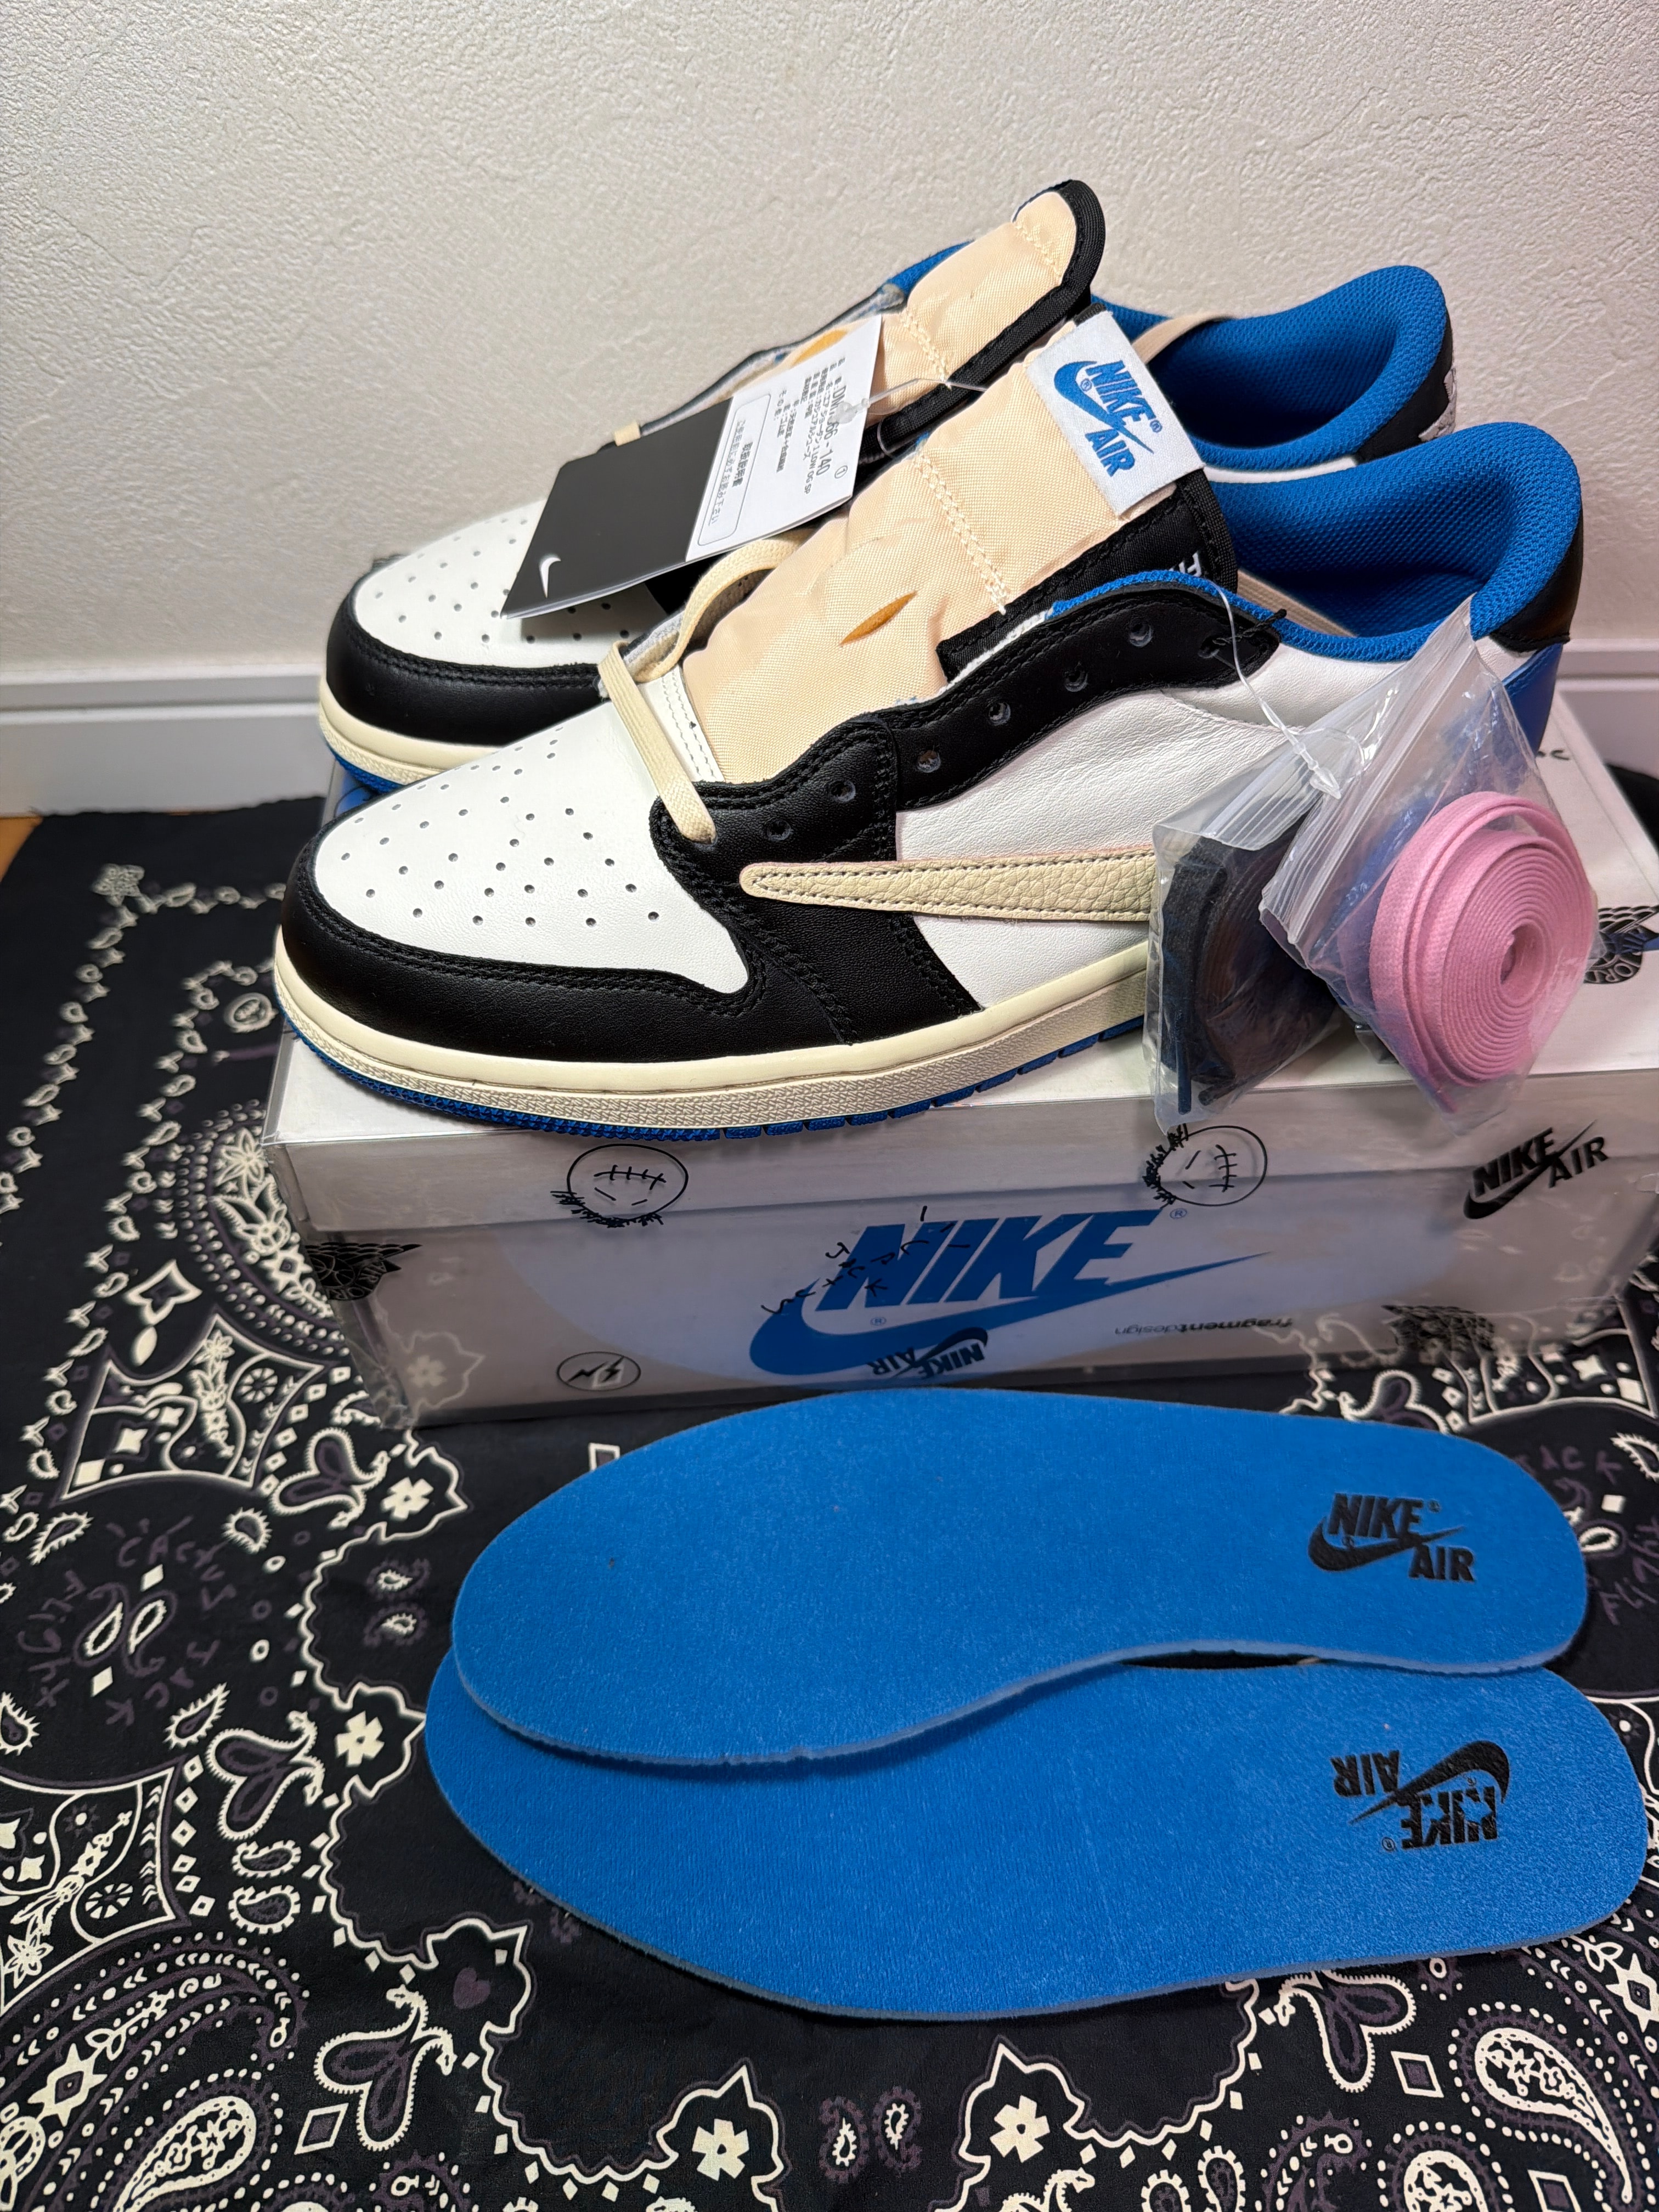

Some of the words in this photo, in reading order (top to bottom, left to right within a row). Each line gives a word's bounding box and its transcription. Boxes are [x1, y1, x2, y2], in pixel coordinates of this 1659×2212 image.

[1085, 359, 1156, 426] NIKE
[816, 385, 847, 476] DM66-140
[1085, 429, 1136, 477] AIR
[1472, 1127, 1554, 1198] NIKE
[1548, 1136, 1608, 1188] AIR
[815, 1209, 1163, 1311] NIKE
[866, 1347, 916, 1376] AIR
[917, 1342, 985, 1380] NIKE
[1327, 1493, 1424, 1539] NIKE
[1408, 1544, 1476, 1583] AIR
[1330, 1750, 1401, 1798] AIR
[1401, 1786, 1498, 1849] NIKE
